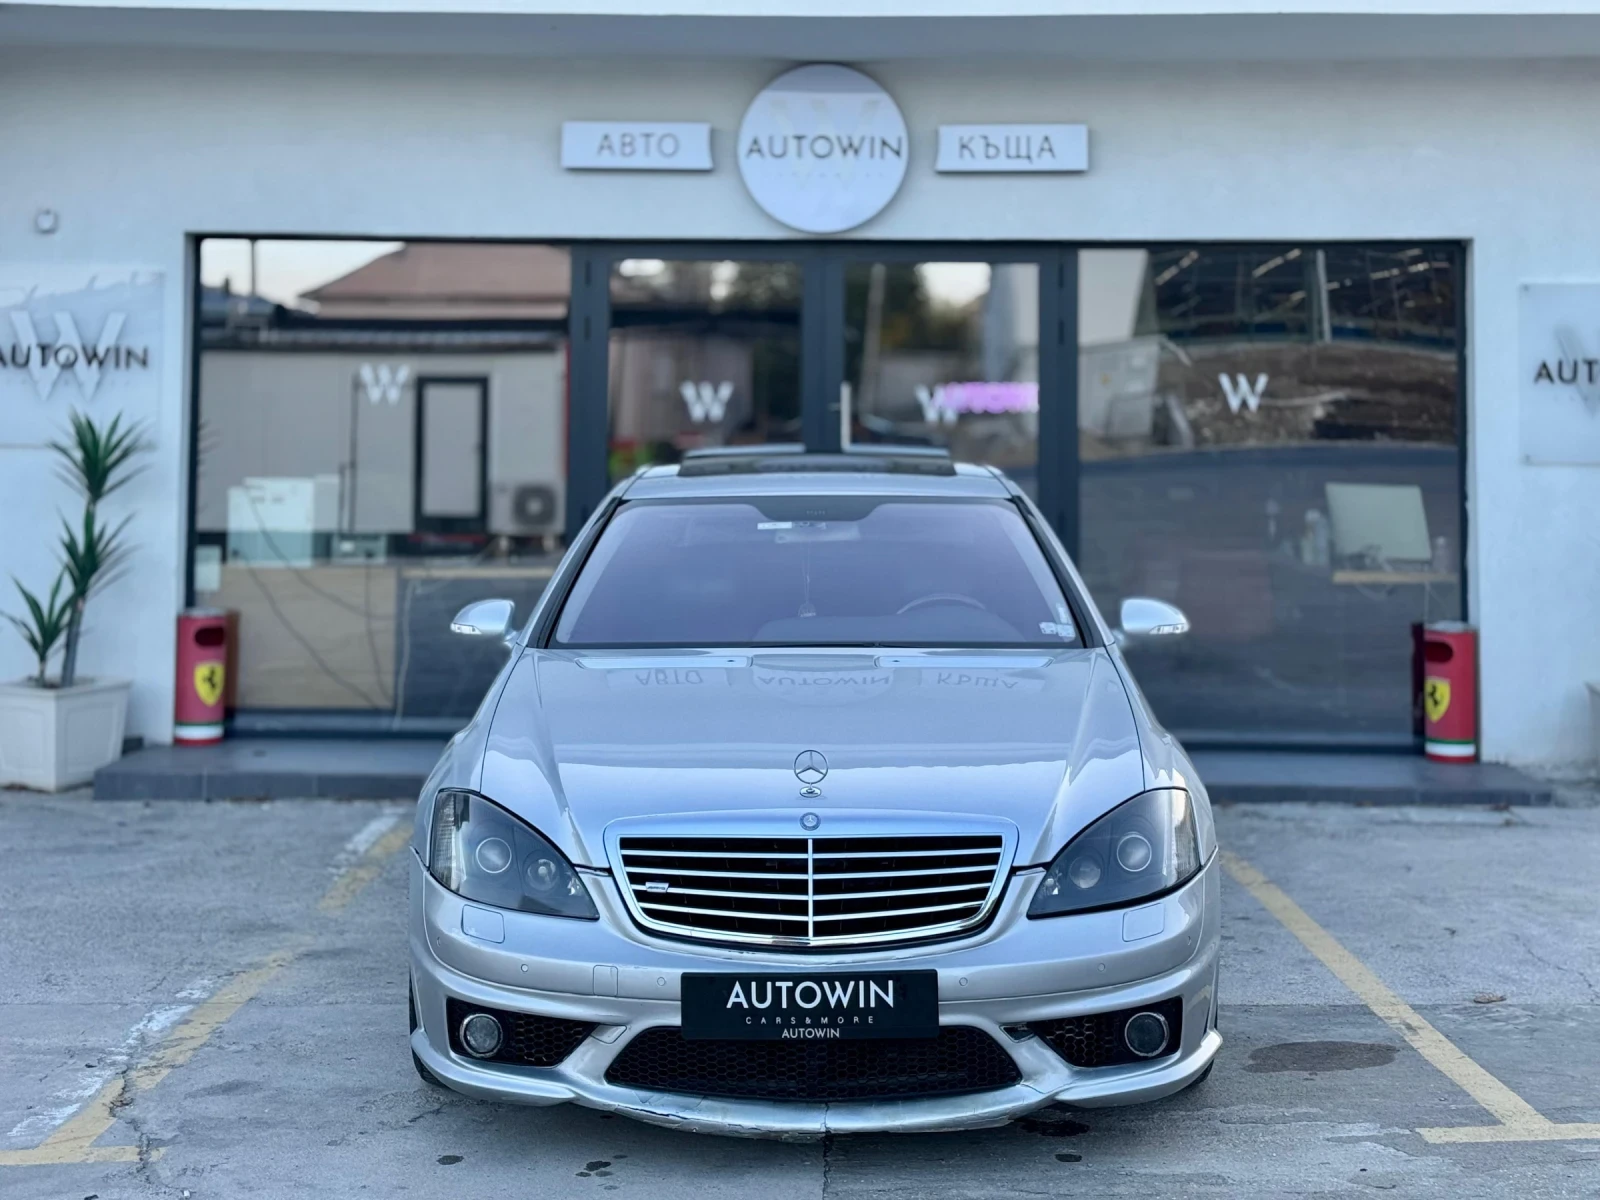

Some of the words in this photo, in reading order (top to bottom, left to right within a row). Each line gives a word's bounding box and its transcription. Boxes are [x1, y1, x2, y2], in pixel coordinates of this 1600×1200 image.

[598, 132, 681, 158] АВТО
[745, 134, 903, 160] AUTOWIN
[957, 134, 1057, 164] КЪЩА
[359, 363, 411, 405] W
[1218, 372, 1269, 414] W
[679, 380, 735, 423] W
[726, 980, 895, 1009] AUTOWIN
[781, 1028, 840, 1039] AUTOWIN
